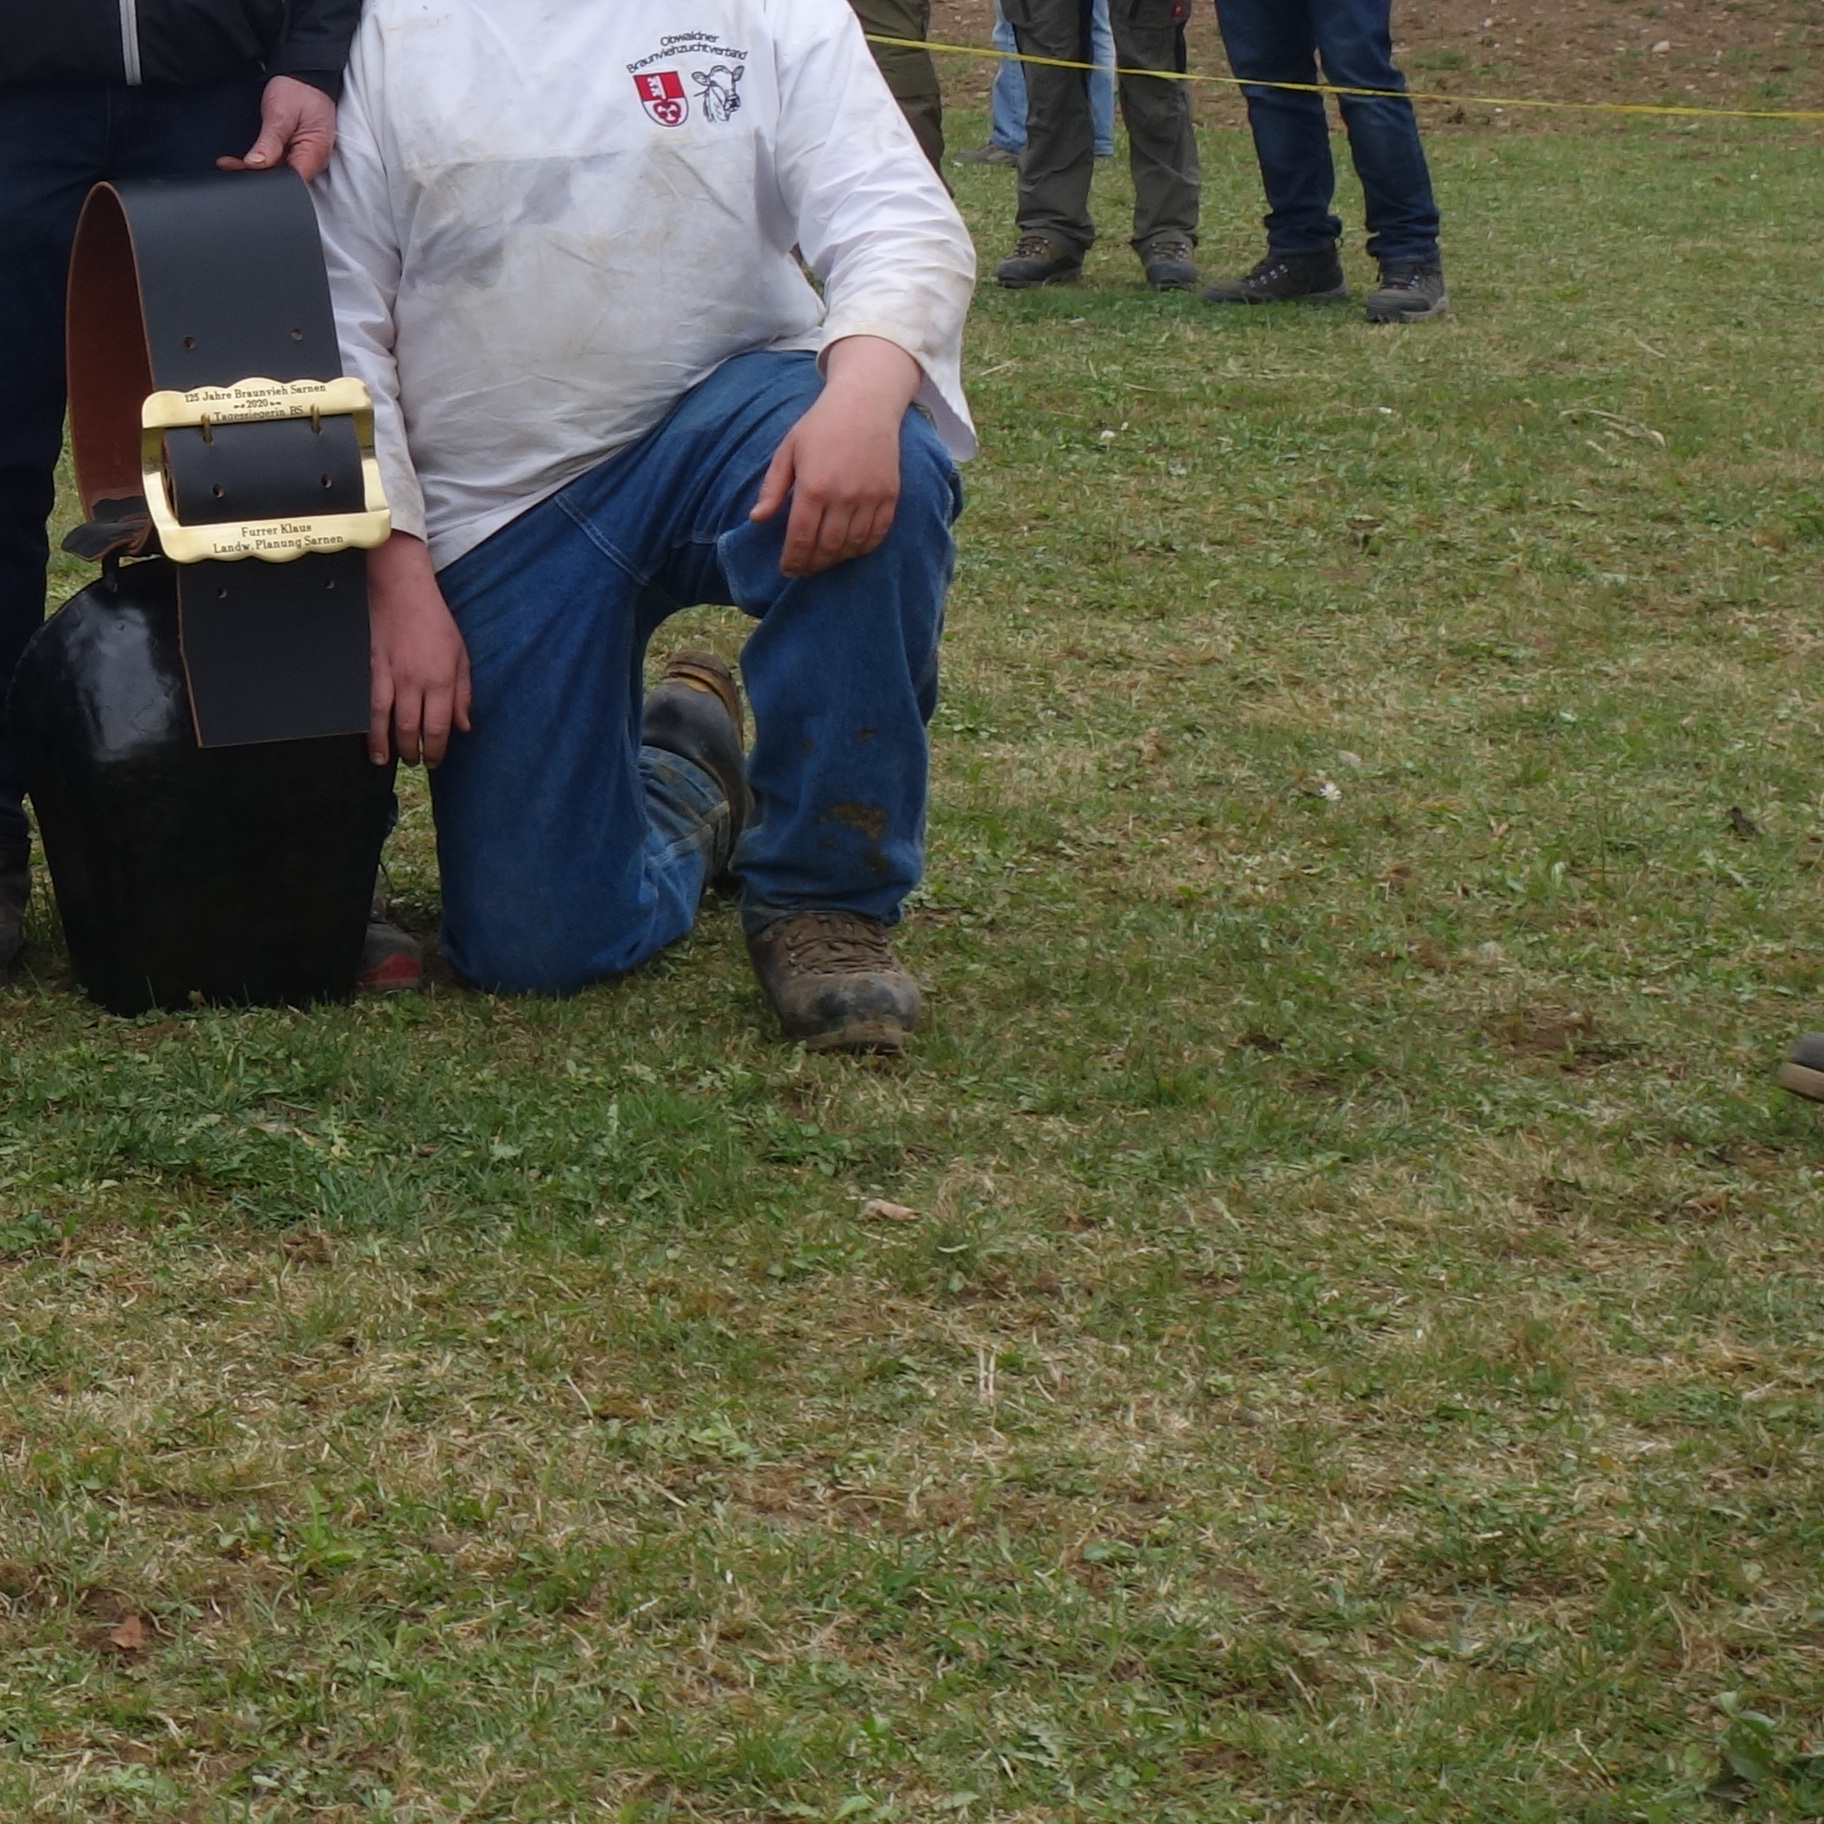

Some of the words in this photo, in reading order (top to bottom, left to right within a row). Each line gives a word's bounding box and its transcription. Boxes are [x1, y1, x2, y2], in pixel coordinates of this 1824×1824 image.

[660, 30, 719, 47] Obwaldner
[626, 42, 748, 74] Braunviehzuchtverband
[184, 392, 200, 403] 125
[202, 391, 232, 401] Jahre
[234, 386, 288, 399] Braunvieh
[290, 384, 327, 394] Sarnen
[246, 399, 269, 409] 2020
[290, 405, 303, 416] BS
[241, 527, 278, 537] Furrer
[280, 523, 312, 534] Klaus
[255, 538, 302, 550] Planung
[304, 535, 344, 547] Sarnen
